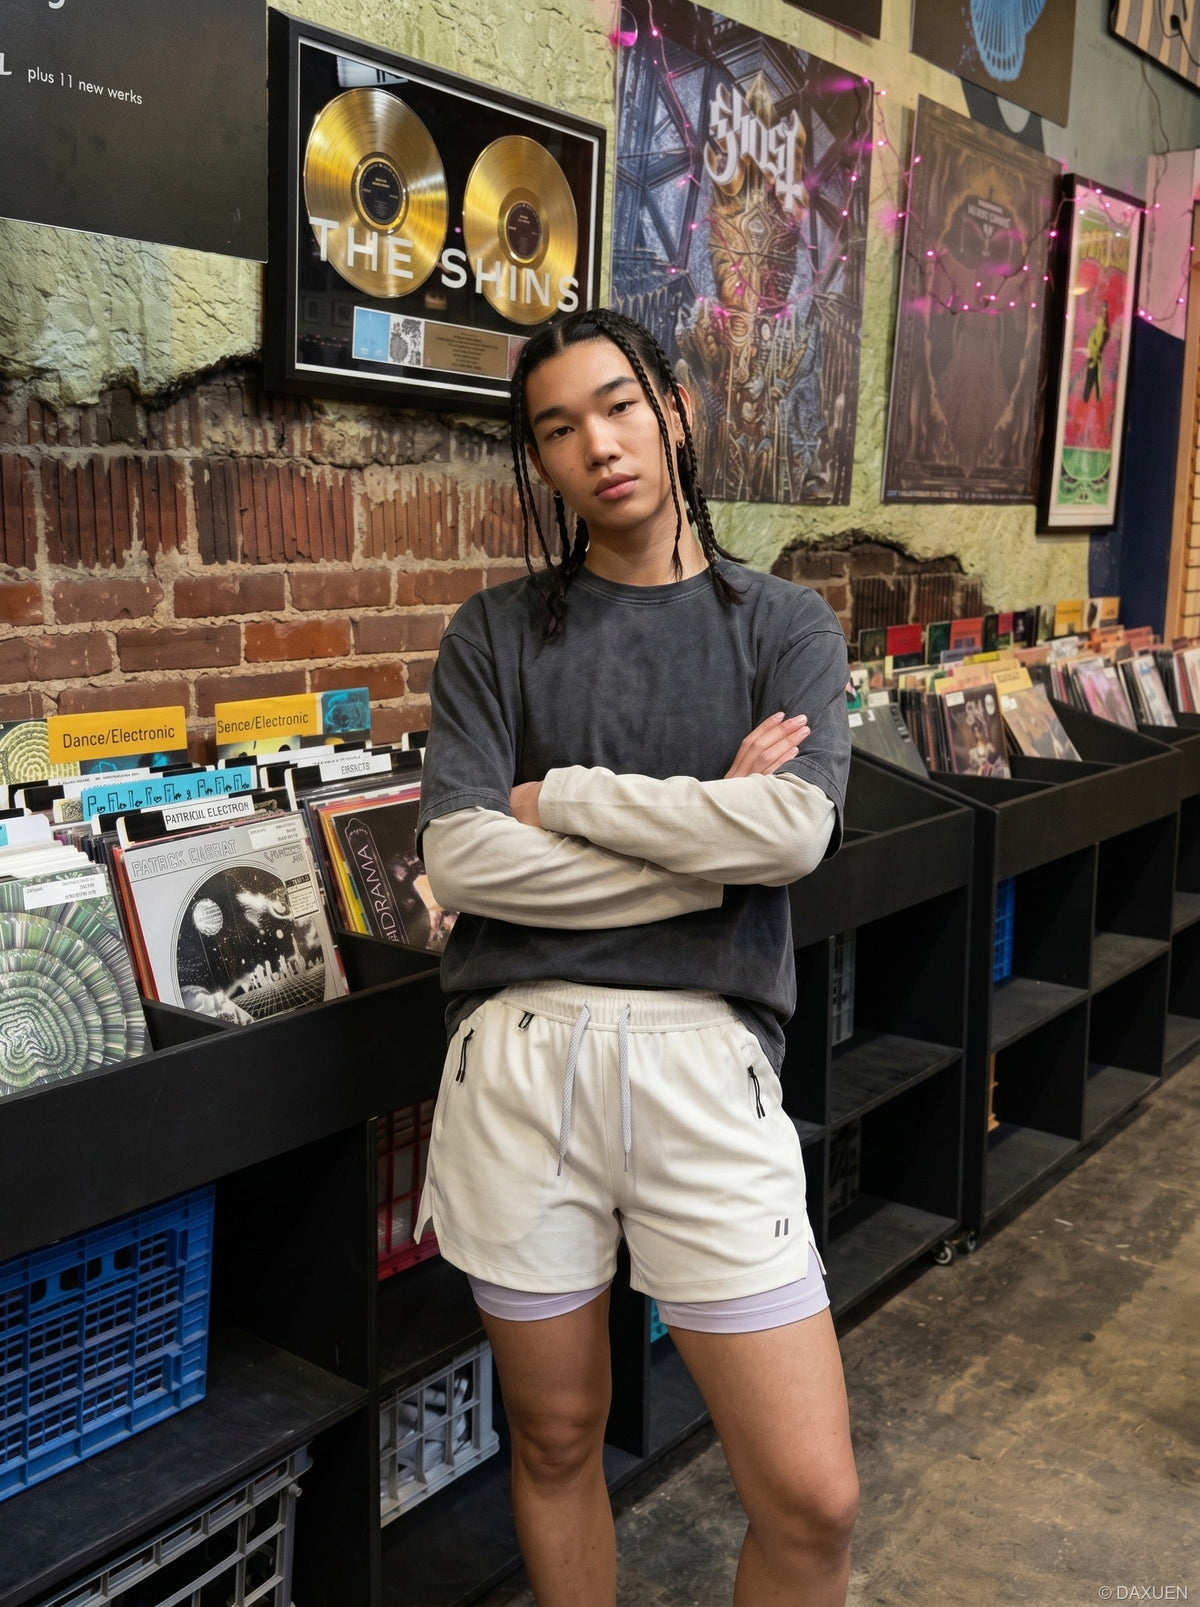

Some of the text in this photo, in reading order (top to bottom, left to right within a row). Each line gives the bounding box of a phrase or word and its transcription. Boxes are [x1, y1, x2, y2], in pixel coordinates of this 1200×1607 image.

[28, 66, 54, 83] plus
[60, 72, 72, 88] 11
[79, 80, 104, 95] new
[107, 89, 143, 105] werks
[309, 216, 579, 313] THE SHINS
[63, 724, 175, 749] Dance/Electronic
[217, 711, 309, 734] Sence/Electronic
